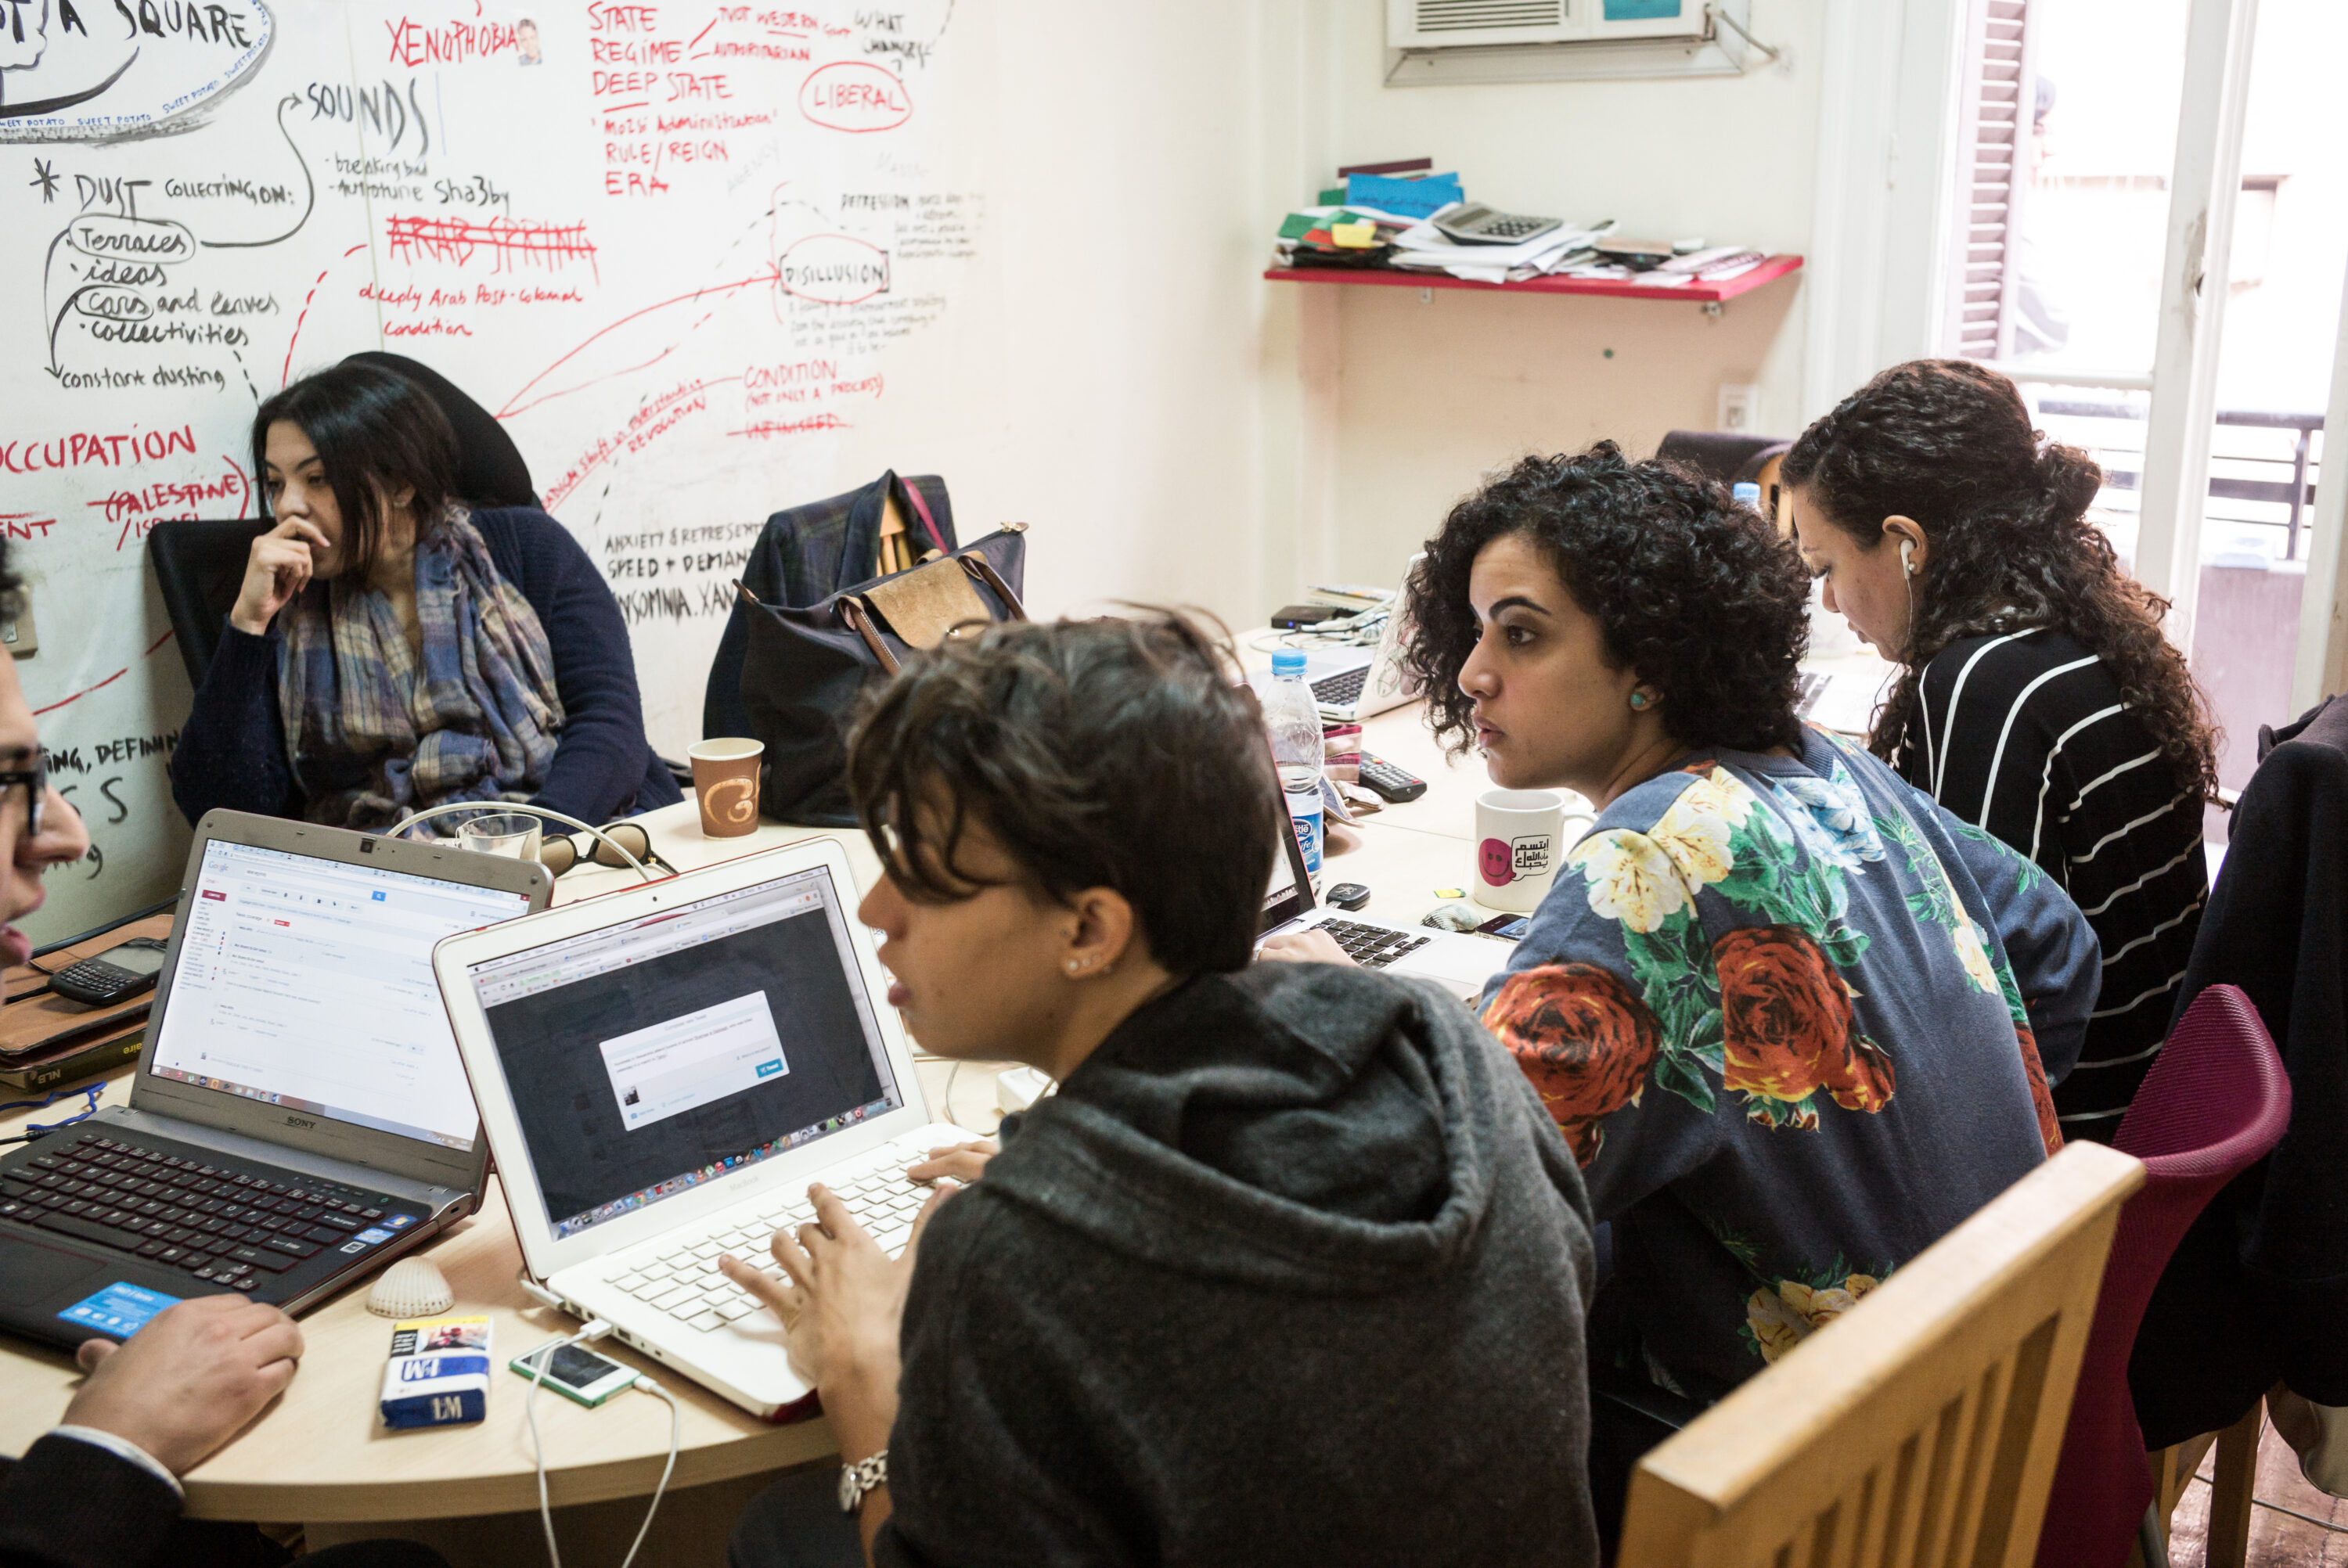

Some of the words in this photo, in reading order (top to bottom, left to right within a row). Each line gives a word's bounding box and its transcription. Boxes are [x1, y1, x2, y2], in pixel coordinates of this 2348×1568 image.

[113, 0, 252, 49] SQUARE
[588, 1, 658, 32] STATE
[855, 9, 903, 33] WHAT
[385, 16, 520, 67] XENOPHOBIA
[592, 71, 658, 95] DEEP
[667, 74, 733, 102] STATE
[814, 83, 906, 111] LIBERAL
[27, 117, 66, 128] POTATO
[117, 113, 153, 125] POTATO
[307, 77, 429, 159] SOUNDS
[605, 170, 669, 196] ERA
[74, 173, 153, 225] DUST
[78, 227, 187, 254] Terraces
[785, 263, 884, 286] DISILLUSION
[157, 287, 203, 313] and
[744, 358, 837, 389] CONDITION
[0, 423, 196, 474] CCUPATION
[0, 519, 56, 541] NT
[605, 530, 664, 554] ANXIETY
[607, 556, 659, 580] SPEED
[682, 548, 753, 574] DEMAN
[286, 1115, 316, 1130] SONY
